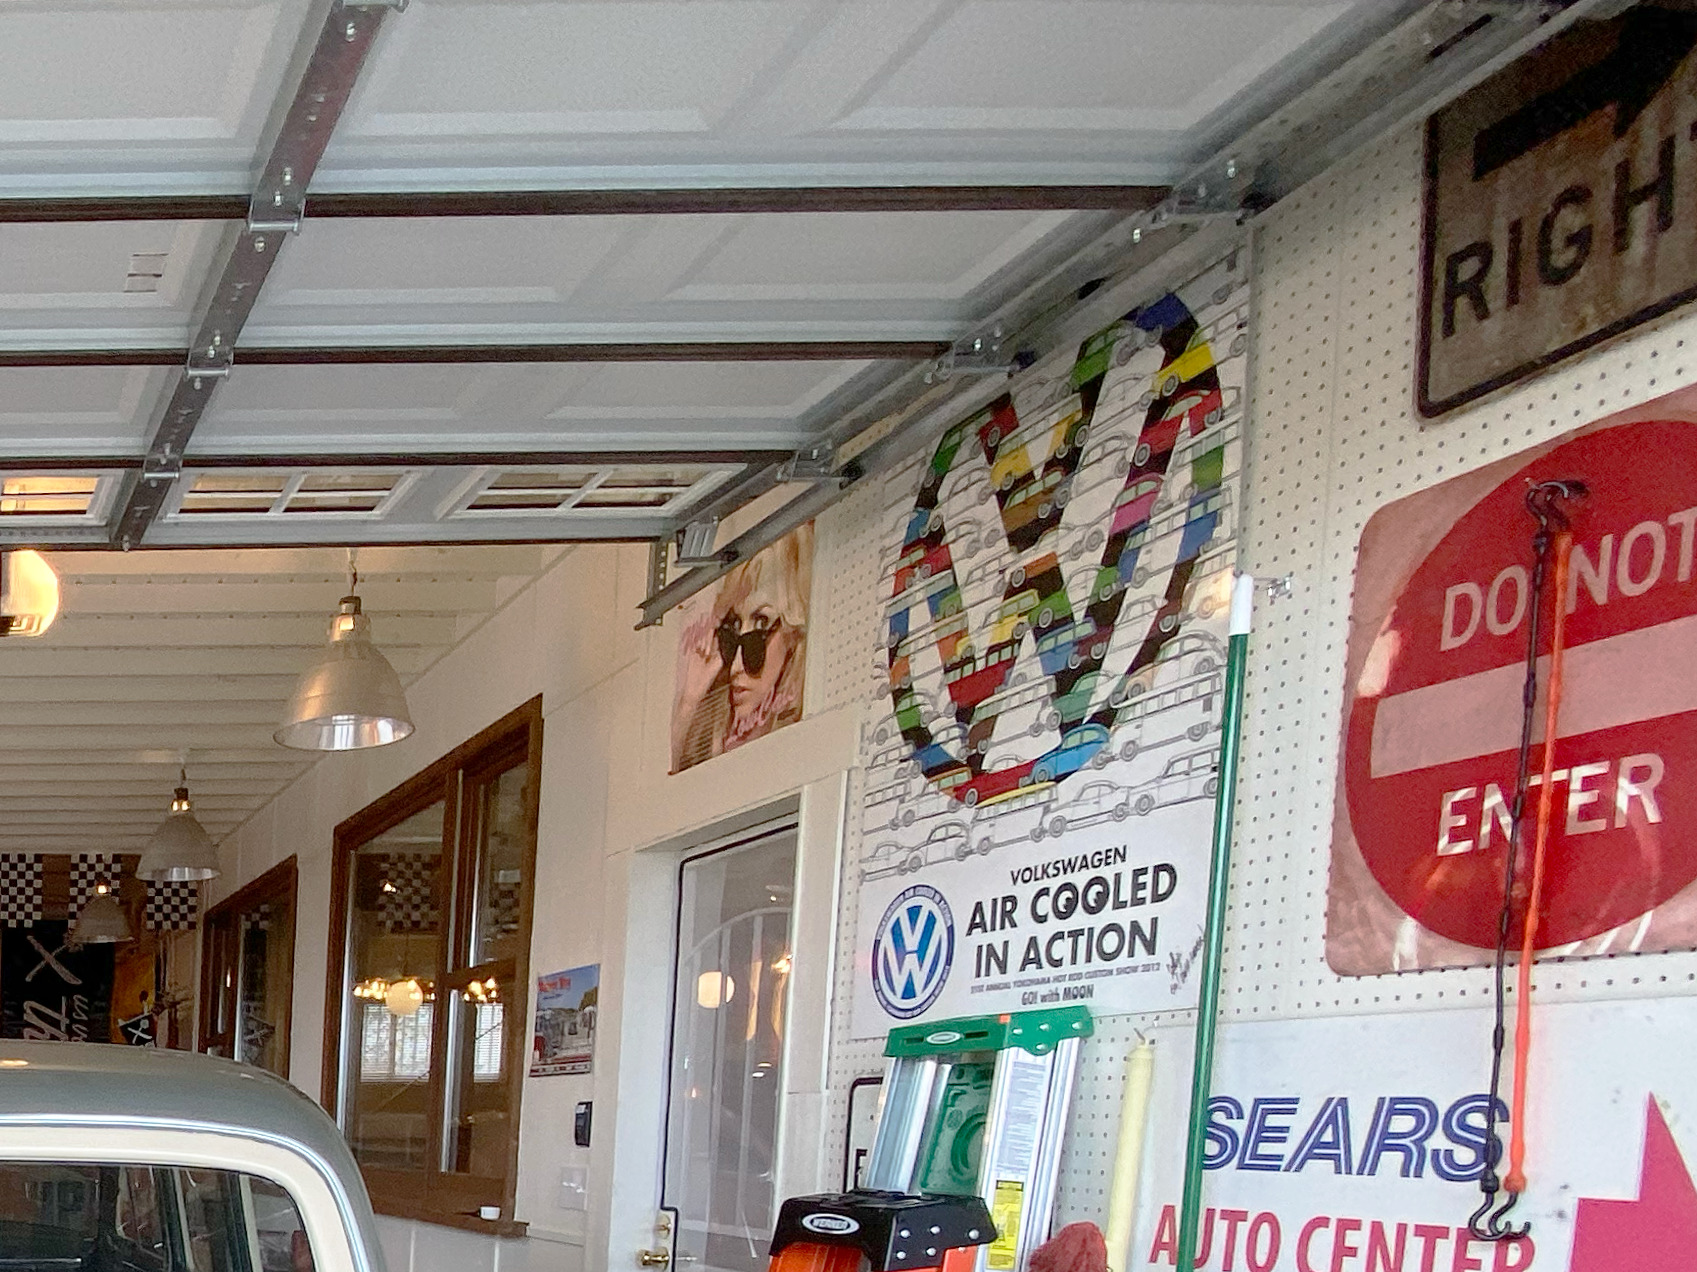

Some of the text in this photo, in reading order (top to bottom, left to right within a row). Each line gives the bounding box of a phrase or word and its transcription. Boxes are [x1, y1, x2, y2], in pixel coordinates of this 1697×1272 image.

[1442, 122, 1697, 339] RIGH
[1440, 507, 1697, 652] DO NOT
[1435, 752, 1665, 857] ENTER
[965, 862, 1178, 937] AIR COOLED
[1009, 845, 1128, 886] VOLKSWAGEN
[974, 940, 1009, 979] IN
[1019, 916, 1159, 973] ACTION
[1062, 984, 1095, 1001] MOON
[1203, 1095, 1511, 1183] SEARS
